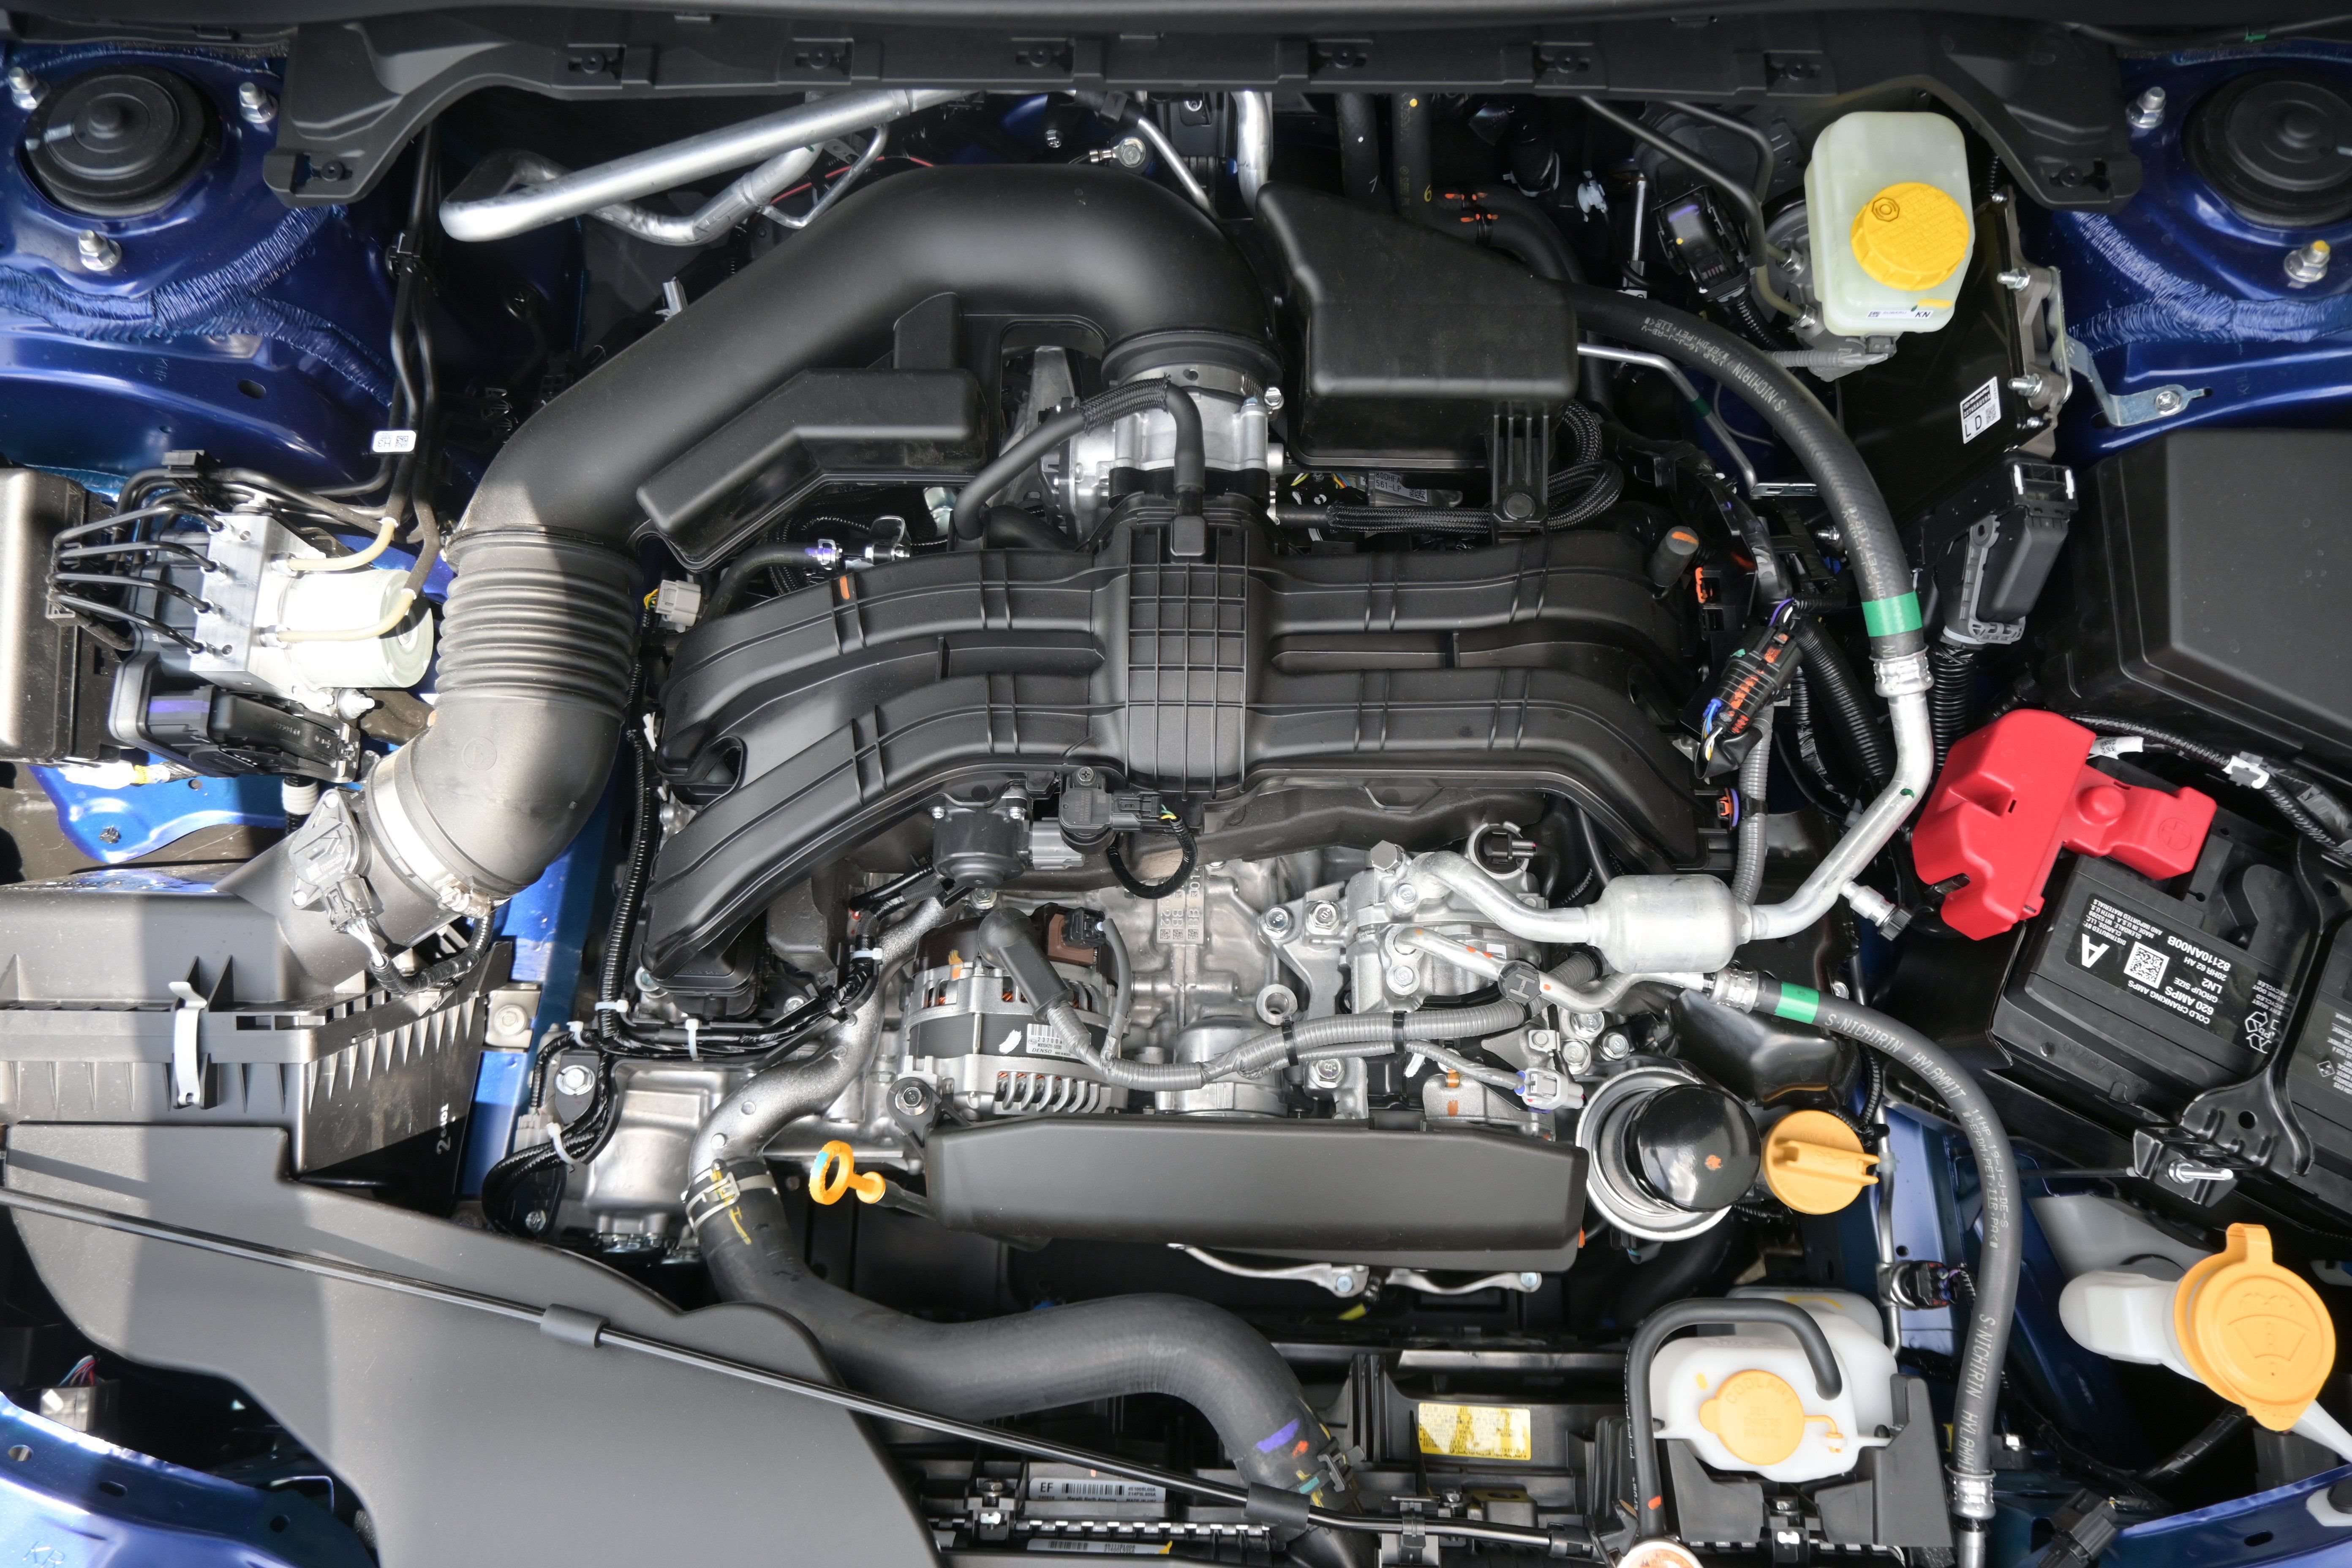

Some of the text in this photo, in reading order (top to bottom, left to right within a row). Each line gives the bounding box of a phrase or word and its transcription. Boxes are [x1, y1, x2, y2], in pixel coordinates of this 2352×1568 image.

[1376, 480, 1401, 492] 561-LP
[2088, 910, 2106, 922] 53209
[2093, 898, 2163, 936] AND IMPORTED MATERIALS
[2101, 909, 2116, 920] WITH
[2104, 917, 2113, 926] WI
[2115, 915, 2134, 928] U.S.A.
[2091, 925, 2127, 946] DISTRIBUTED
[2138, 927, 2155, 939] MADE
[2081, 933, 2110, 968] A
[2166, 934, 2232, 972] 82110AN00B
[2183, 956, 2227, 981] 20HR 62 AH
[2173, 977, 2219, 1004] GROUP SIZE
[2200, 977, 2223, 994] LN2
[2127, 979, 2211, 1024] COLD CRANKING AMPS
[2163, 985, 2215, 1015] 620 AMPS
[2251, 998, 2269, 1010] MUST
[2257, 1027, 2272, 1039] Pb
[1908, 1052, 1967, 1102] HYLAMMIT
[1971, 1107, 1992, 1137] 11HP
[1725, 1376, 1797, 1404] COOLANT
[1040, 1482, 1054, 1493] EF
